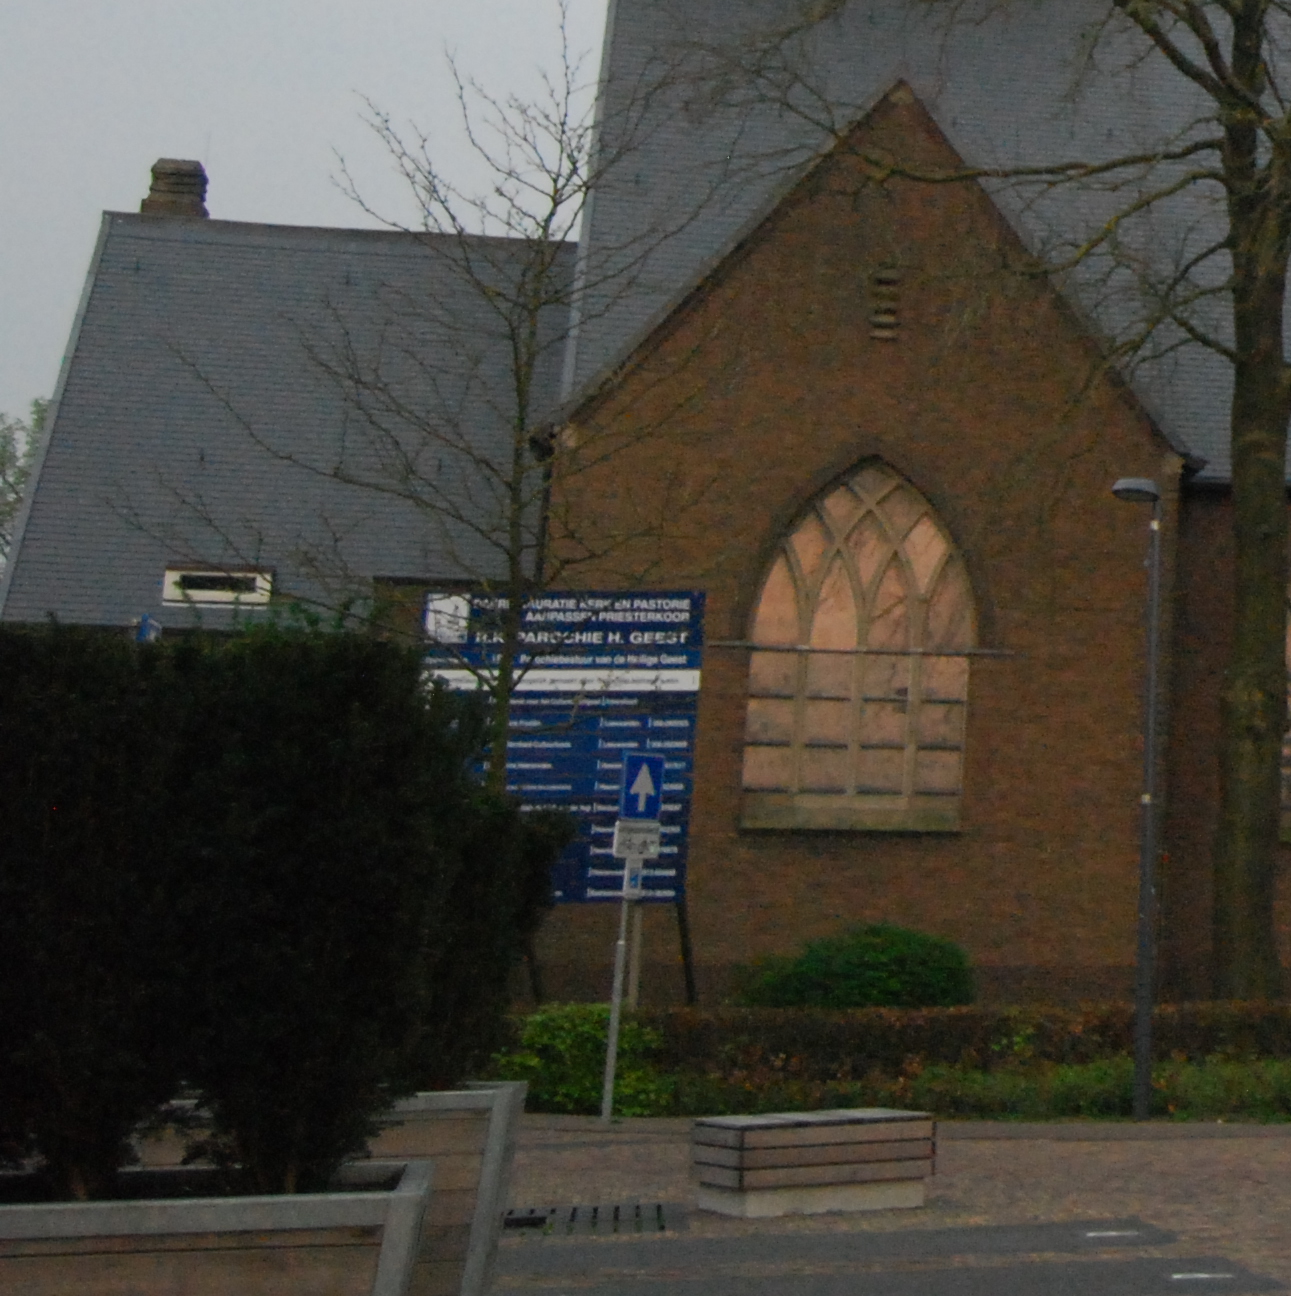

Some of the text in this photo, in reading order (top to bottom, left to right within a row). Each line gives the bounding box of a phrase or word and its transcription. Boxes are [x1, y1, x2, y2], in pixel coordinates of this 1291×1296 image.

[614, 599, 631, 610] EN
[633, 599, 691, 610] PASTORIE
[598, 611, 691, 622] PRIESTERKOOR
[517, 631, 603, 644] PAROCHIE
[607, 631, 624, 644] H.
[629, 631, 689, 644] GEEST
[519, 653, 593, 664] Paochiebestuur
